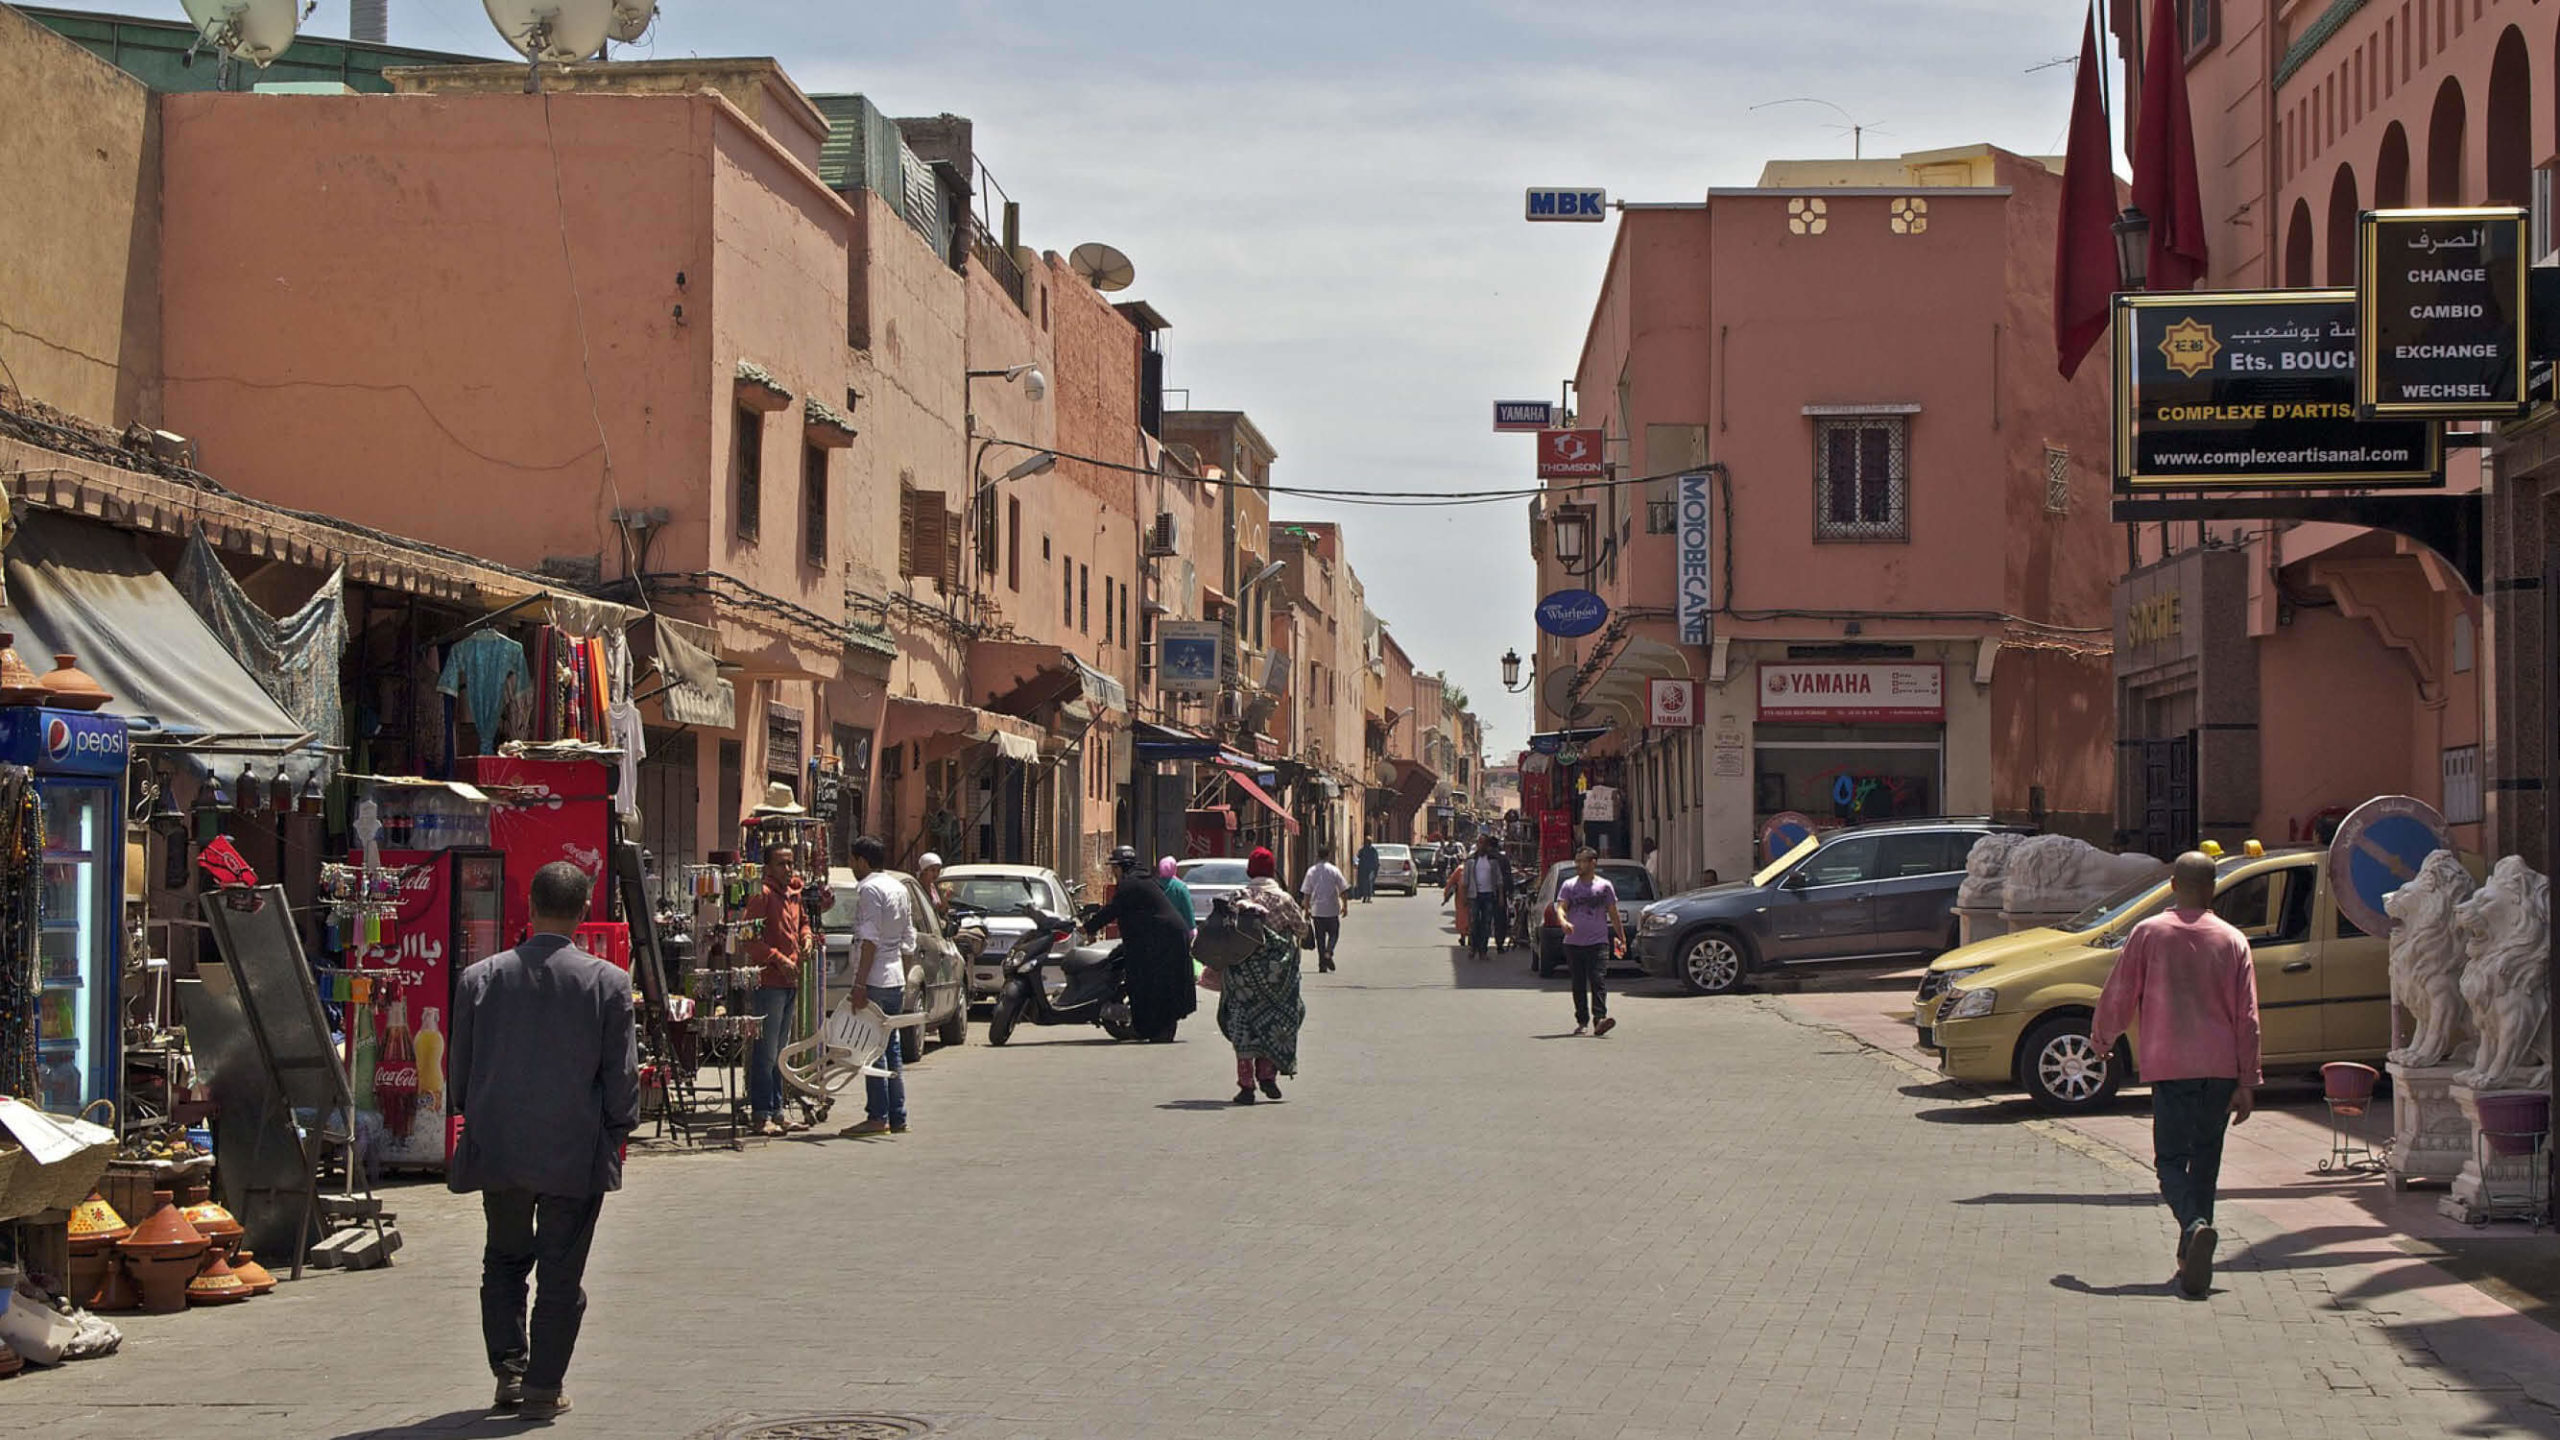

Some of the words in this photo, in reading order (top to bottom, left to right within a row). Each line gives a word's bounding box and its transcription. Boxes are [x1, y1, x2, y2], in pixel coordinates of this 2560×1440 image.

[1530, 192, 1602, 215] MBK
[2407, 227, 2486, 255] الصرف
[2407, 268, 2486, 283] CHANGE
[2409, 304, 2483, 319] CAMBIO
[2395, 343, 2498, 359] EXCHANGE
[2230, 352, 2274, 371] Ets.
[2402, 384, 2492, 398] WECHSEL
[1500, 406, 1545, 421] YAMAHA
[2157, 404, 2266, 422] COMPLEXE
[2154, 446, 2409, 467] www.complexeartisanal.com
[1540, 463, 1601, 472] THOMSON
[1683, 477, 1707, 643] MOTOBECANE
[1543, 604, 1598, 621] Whirlpool
[1790, 673, 1872, 694] YAMAHA
[75, 729, 123, 760] pepsi
